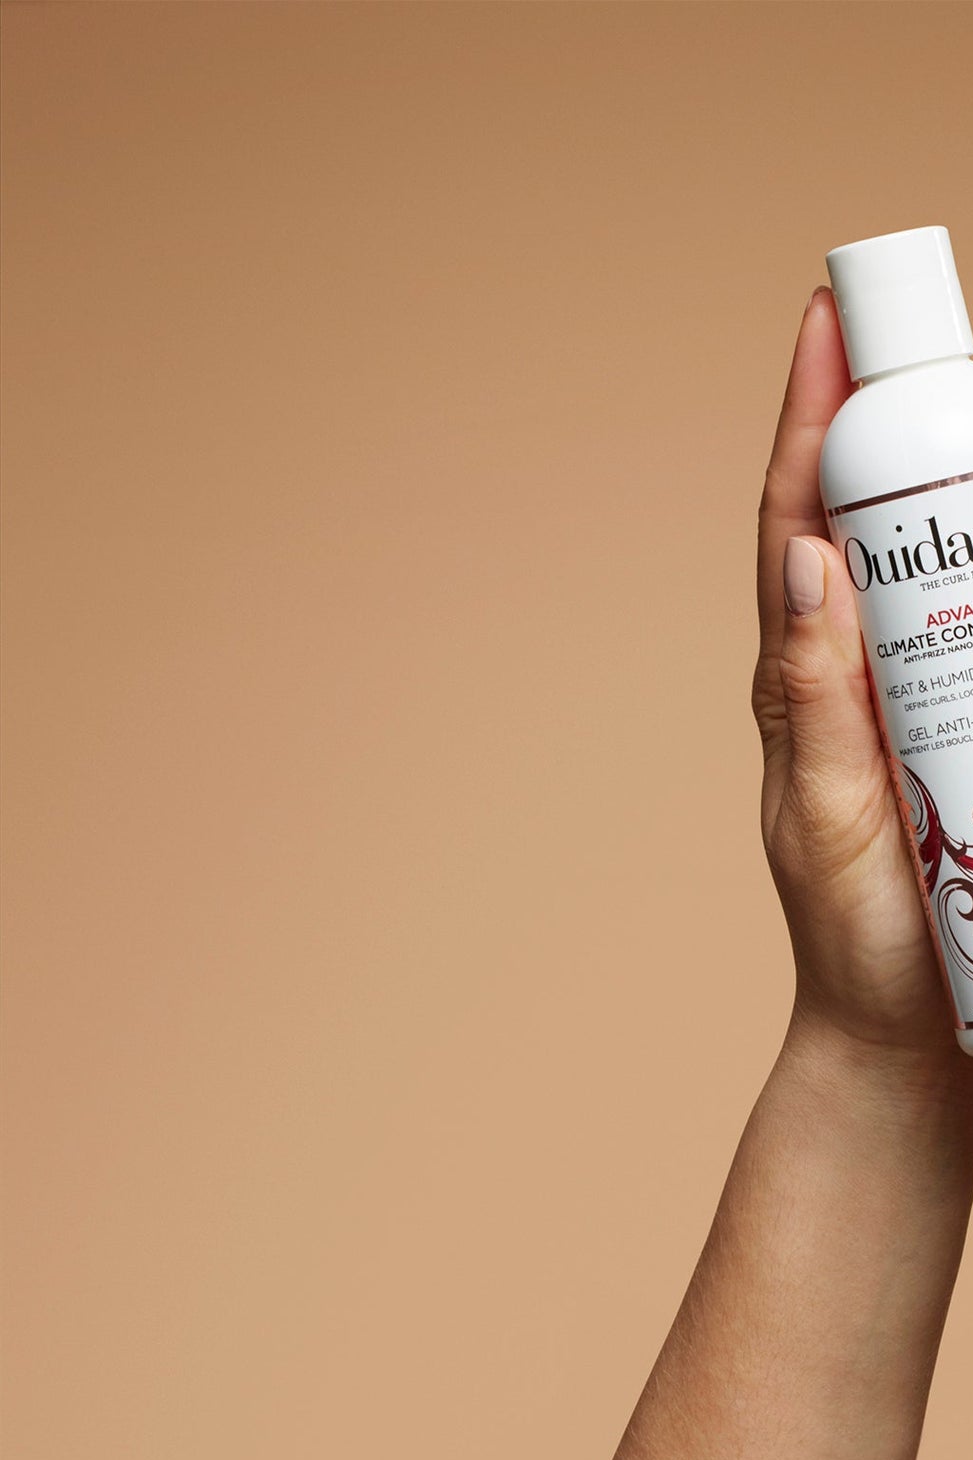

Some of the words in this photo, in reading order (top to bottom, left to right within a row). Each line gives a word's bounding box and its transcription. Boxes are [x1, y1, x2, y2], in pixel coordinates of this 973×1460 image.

[920, 579, 941, 592] THE
[942, 572, 970, 586] CURL
[876, 632, 938, 659] CLIMATE
[903, 648, 946, 665] ANTI-FRIZZ
[948, 641, 973, 654] NANO
[886, 682, 914, 700] HEAT
[918, 680, 928, 693] &
[904, 701, 929, 712] DEFINE
[908, 727, 933, 742] GEL
[931, 741, 945, 751] LES
